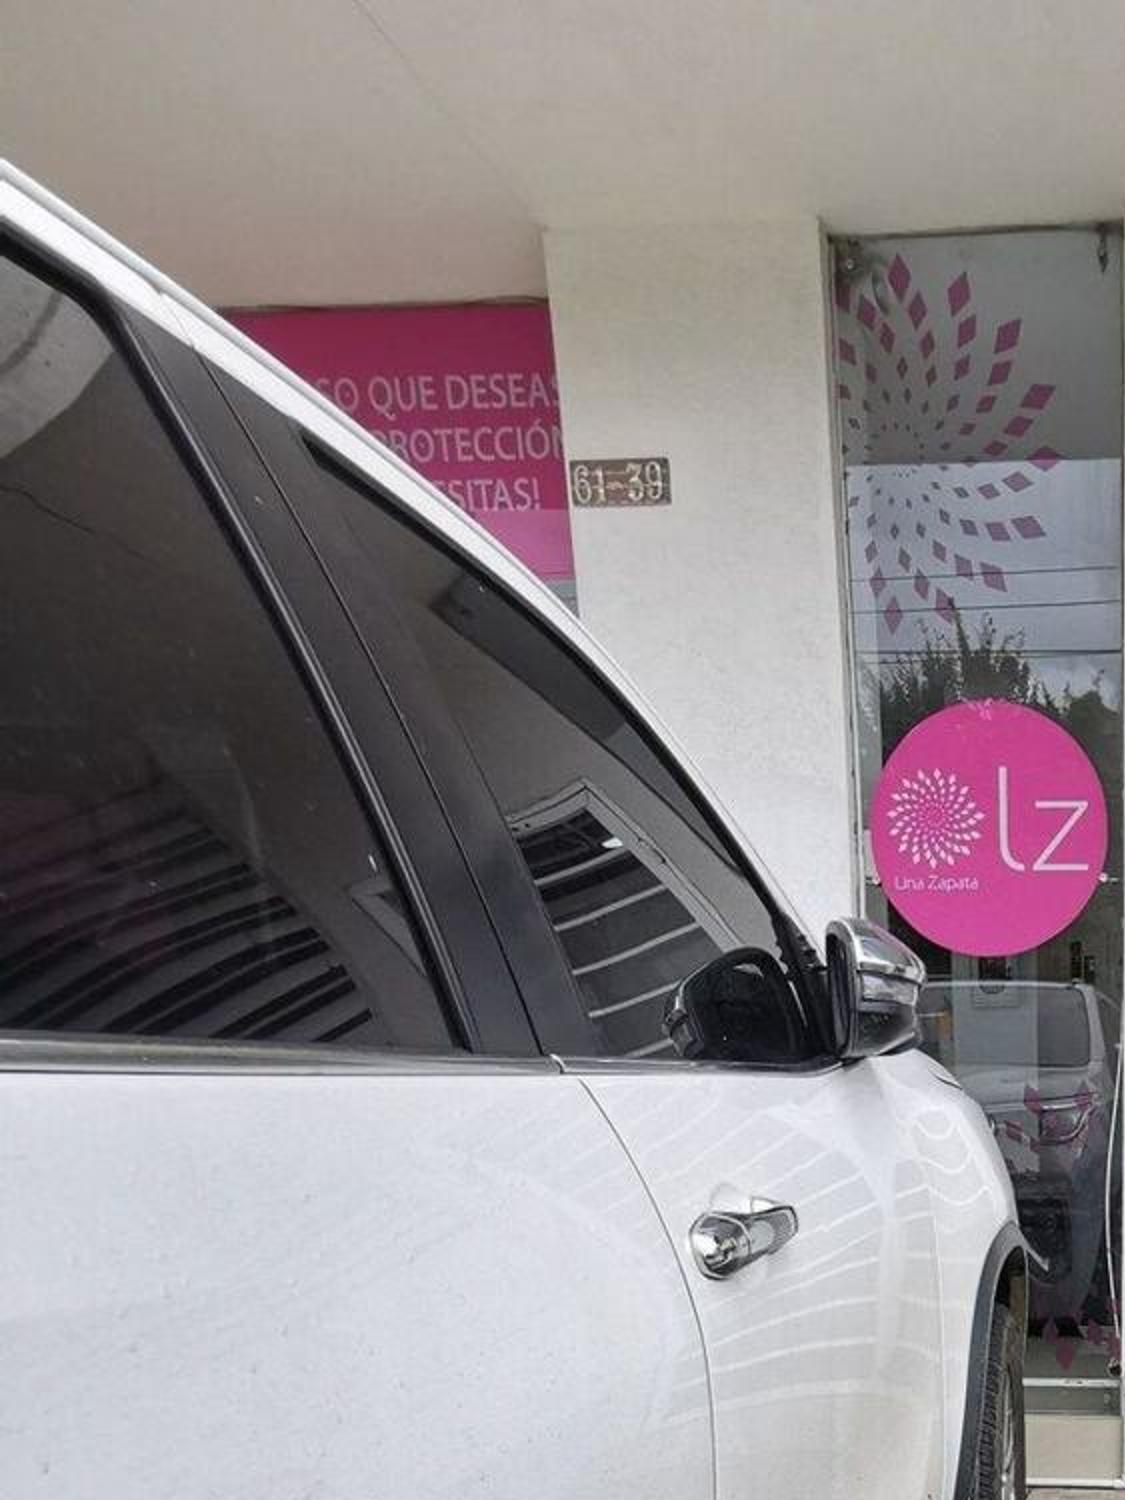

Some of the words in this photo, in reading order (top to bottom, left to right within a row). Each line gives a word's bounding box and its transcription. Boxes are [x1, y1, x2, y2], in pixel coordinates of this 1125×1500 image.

[368, 375, 438, 421] QUE
[433, 477, 541, 513] SITAS!
[574, 461, 662, 504] 61-39
[895, 875, 925, 891] Lina
[927, 874, 979, 893] Zapata
